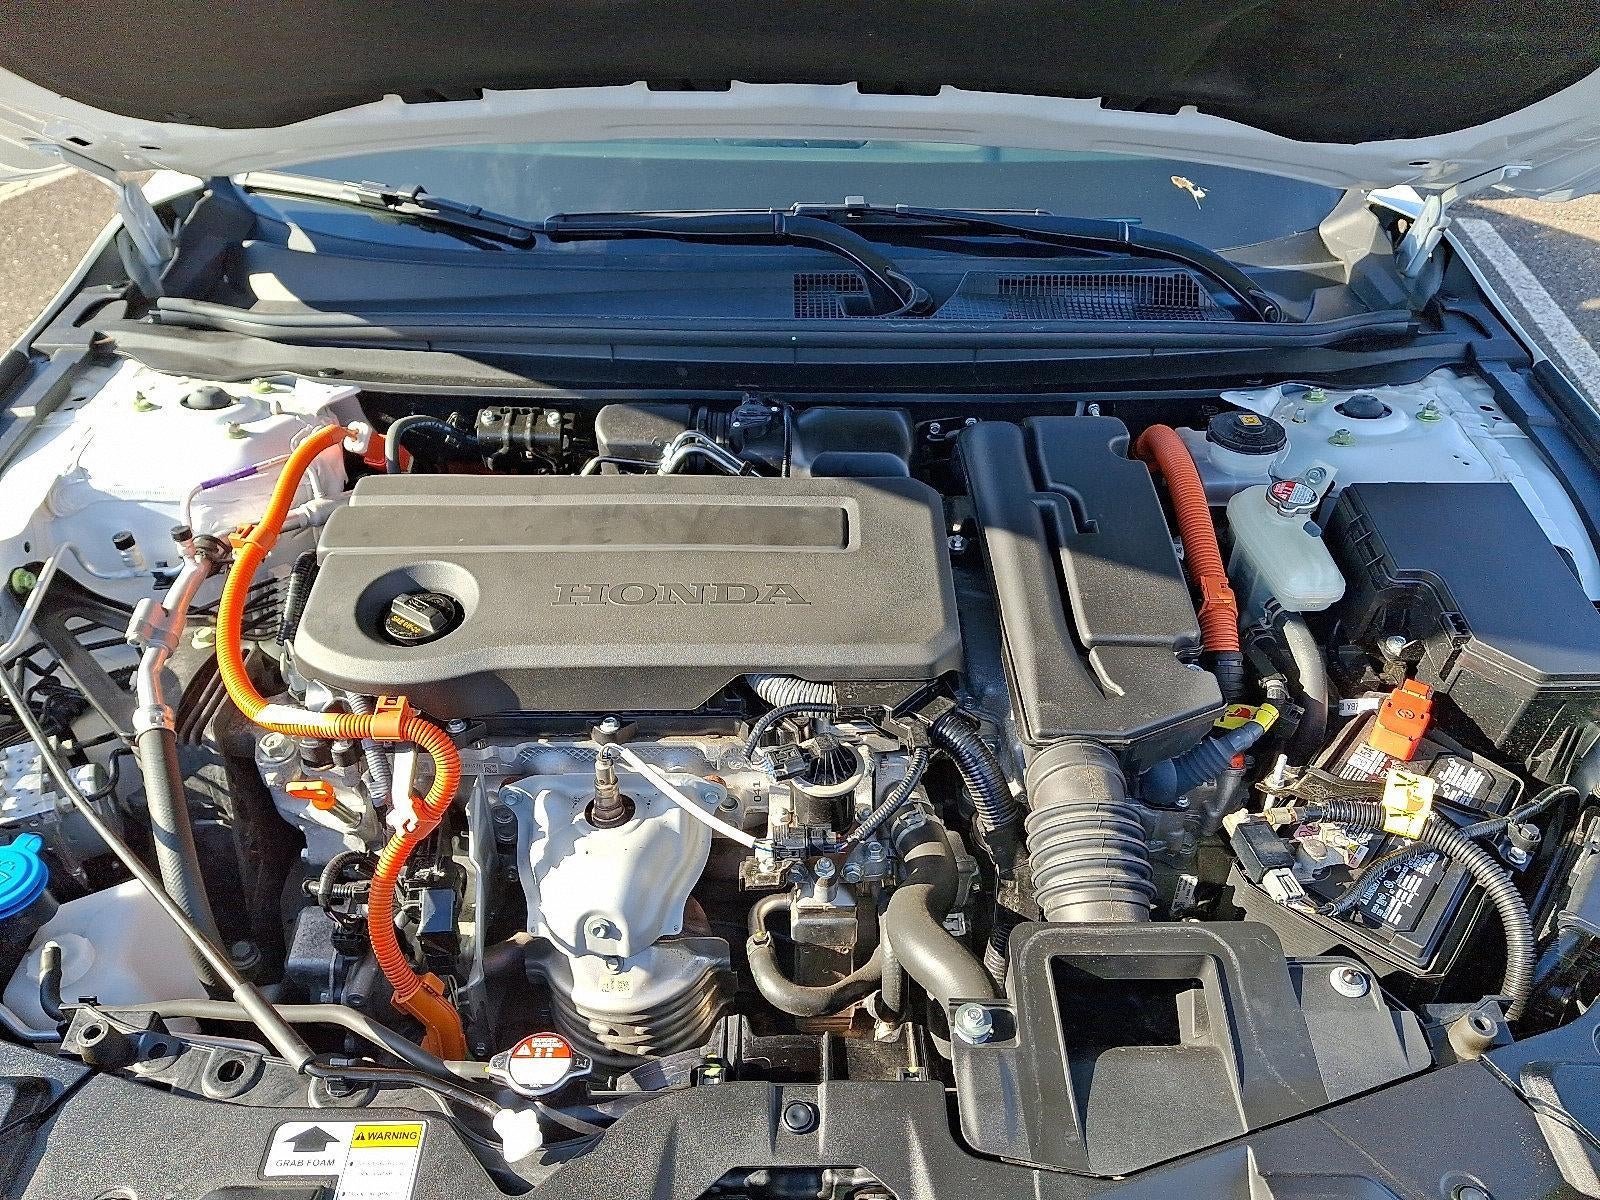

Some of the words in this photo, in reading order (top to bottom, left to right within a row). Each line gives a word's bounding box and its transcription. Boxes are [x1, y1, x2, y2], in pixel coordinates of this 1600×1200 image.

[551, 582, 812, 606] HONDA
[367, 1131, 418, 1141] WARNING
[275, 1159, 304, 1167] GRAB
[306, 1158, 335, 1167] FOAM
